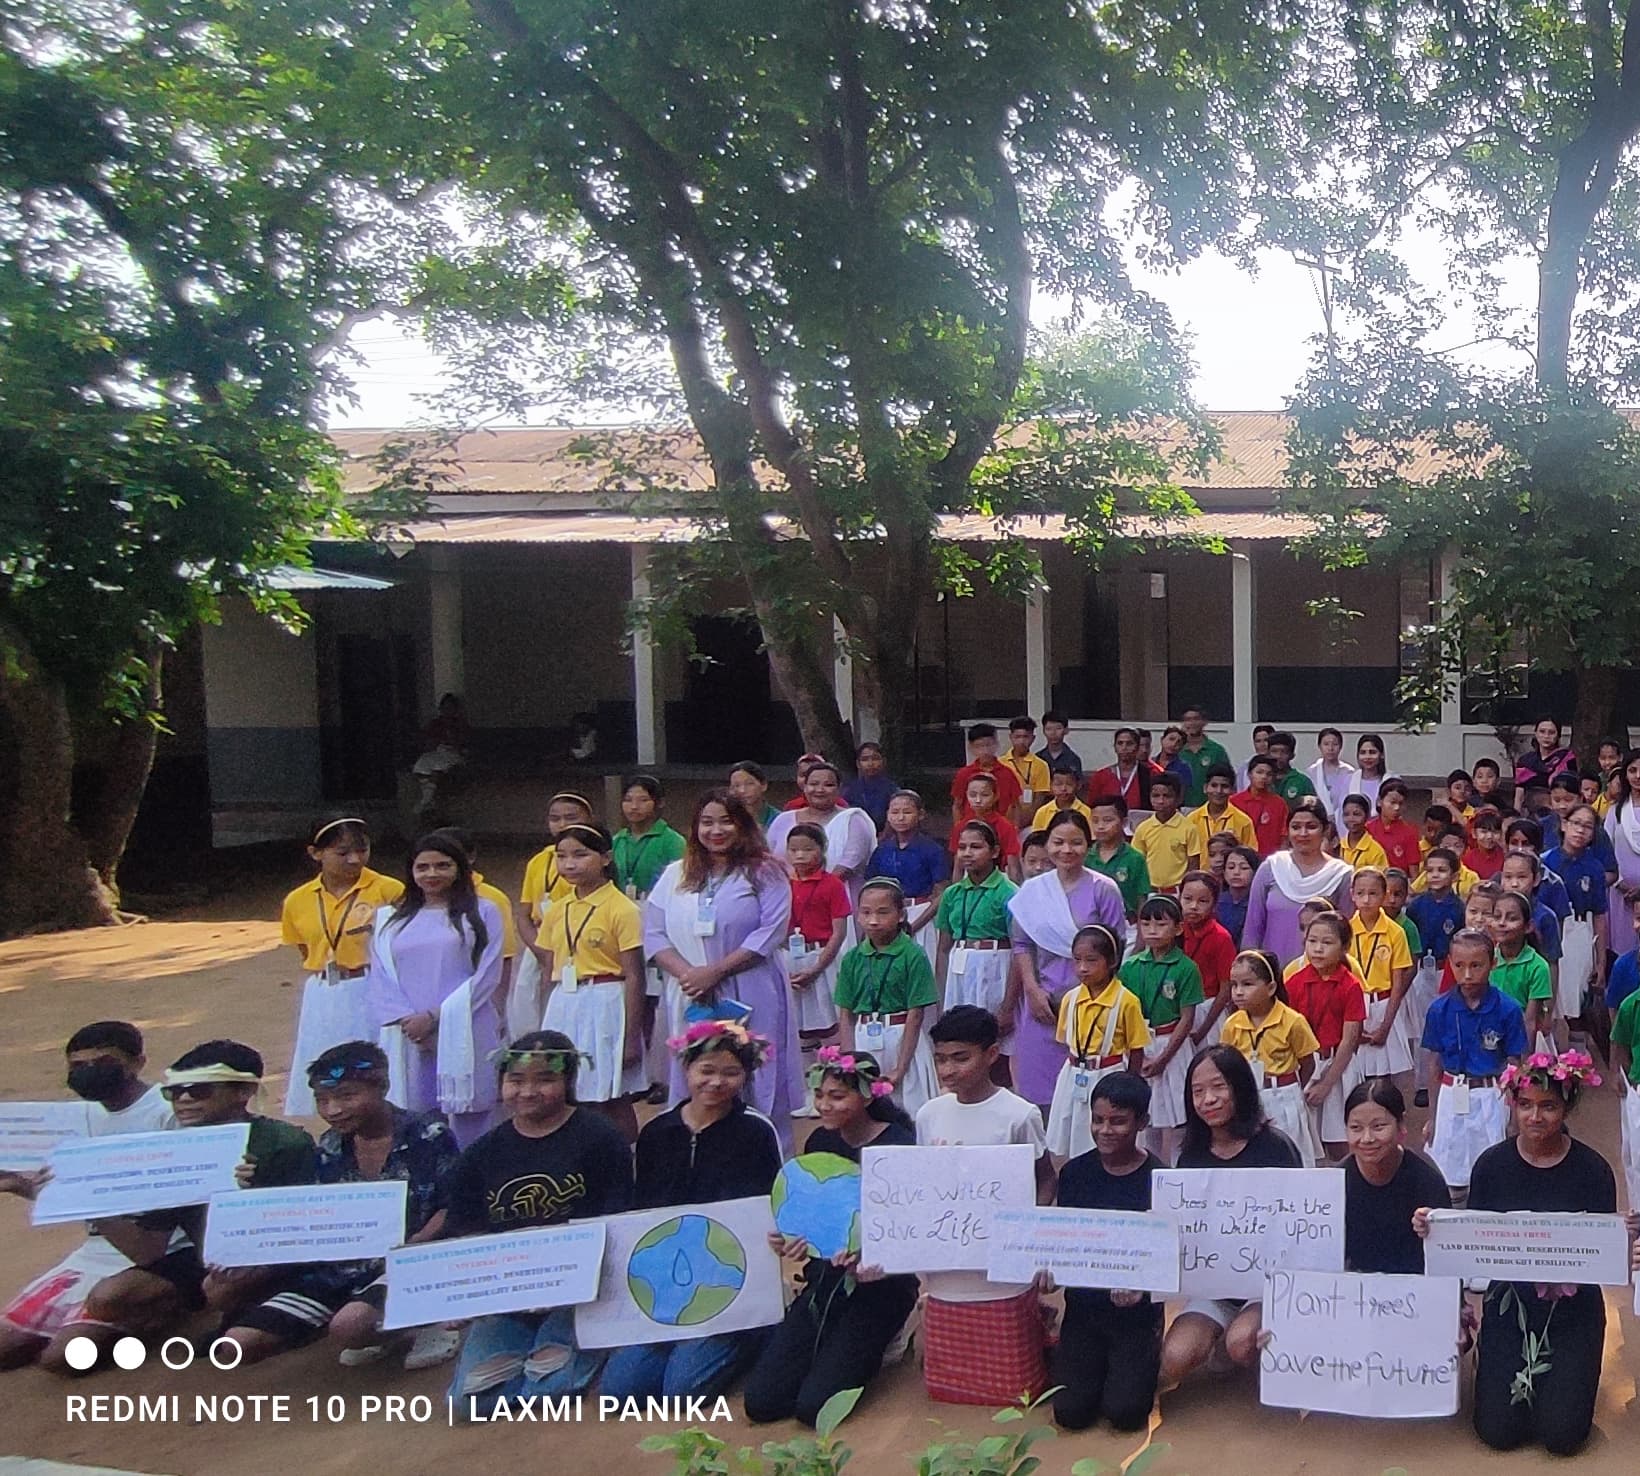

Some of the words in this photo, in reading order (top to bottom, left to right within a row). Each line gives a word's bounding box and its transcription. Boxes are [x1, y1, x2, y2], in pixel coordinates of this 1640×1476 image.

[1304, 1198, 1331, 1215] the
[868, 1217, 919, 1242] Save
[1181, 1245, 1219, 1271] the
